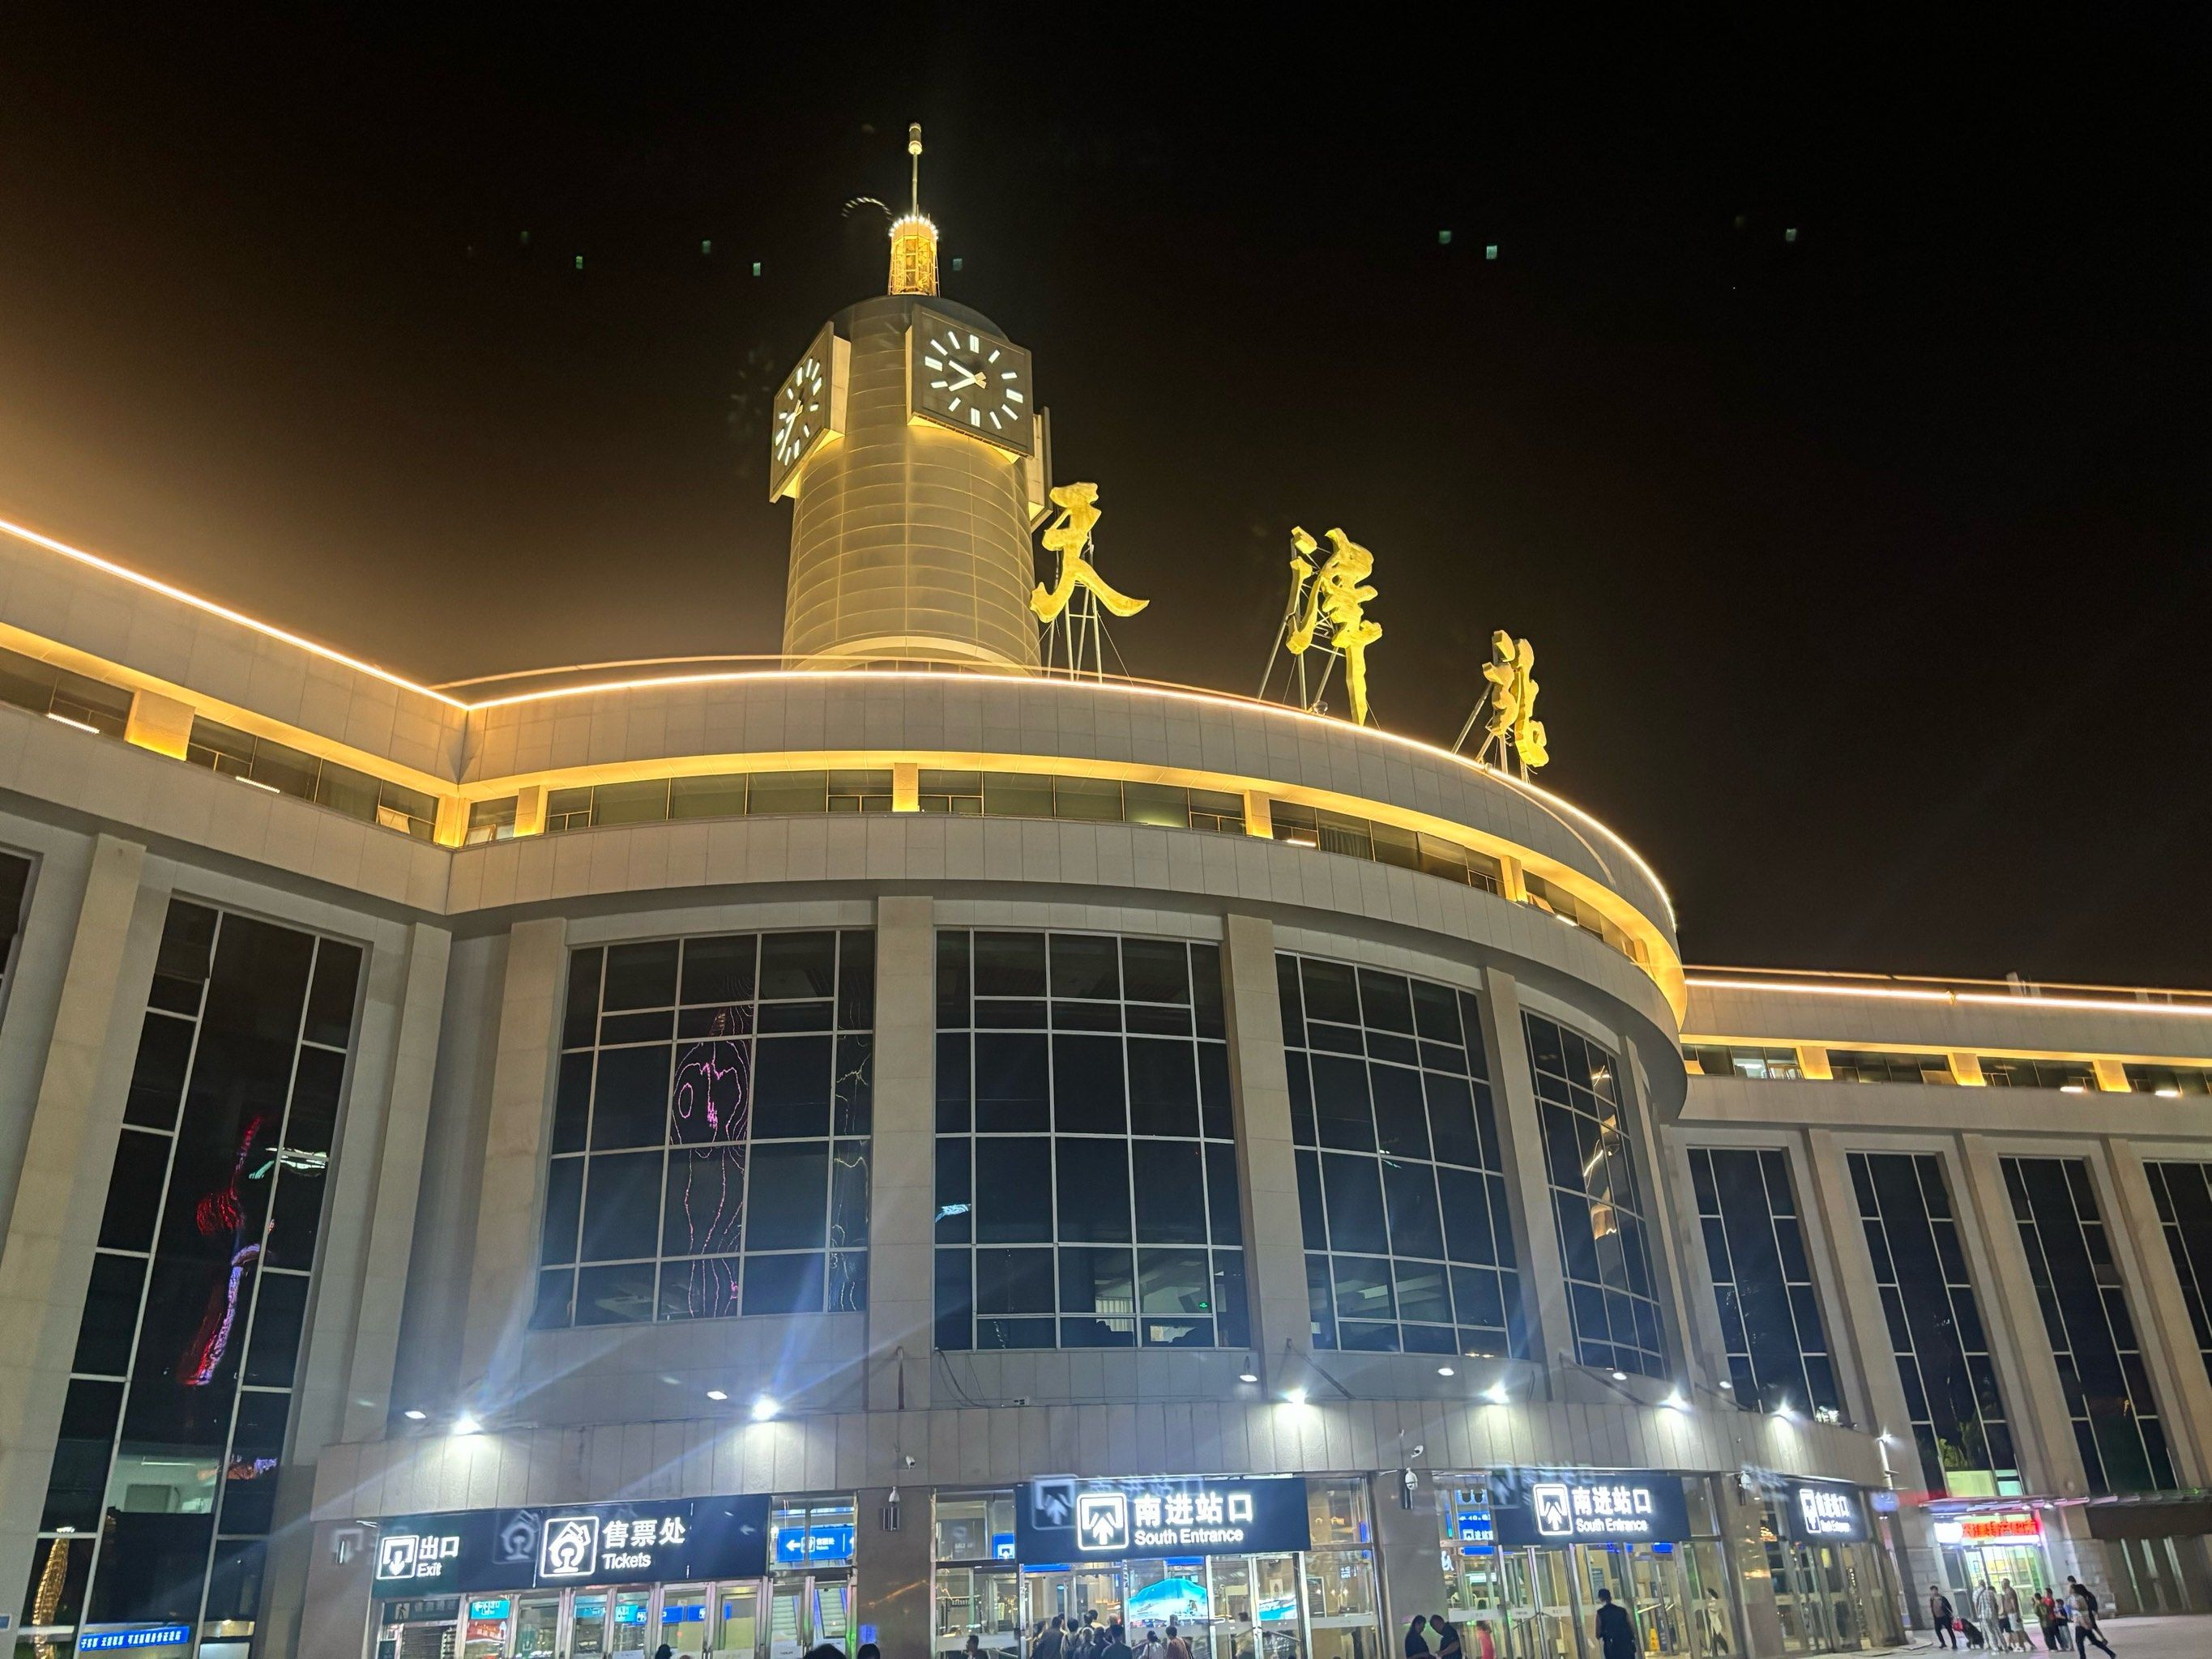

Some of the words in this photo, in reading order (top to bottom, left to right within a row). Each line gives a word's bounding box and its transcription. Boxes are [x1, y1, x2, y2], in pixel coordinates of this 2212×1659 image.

[1031, 481, 1549, 768] 天津站
[1134, 1491, 1253, 1527] 南进站口
[1572, 1486, 1651, 1515] 南进站口
[601, 1516, 686, 1549] 售票处
[1134, 1529, 1177, 1546] South
[1180, 1528, 1245, 1544] Entrance
[1576, 1517, 1604, 1533] South
[419, 1535, 460, 1560] 出口
[416, 1562, 442, 1578] Exit
[601, 1551, 651, 1570] Tickets
